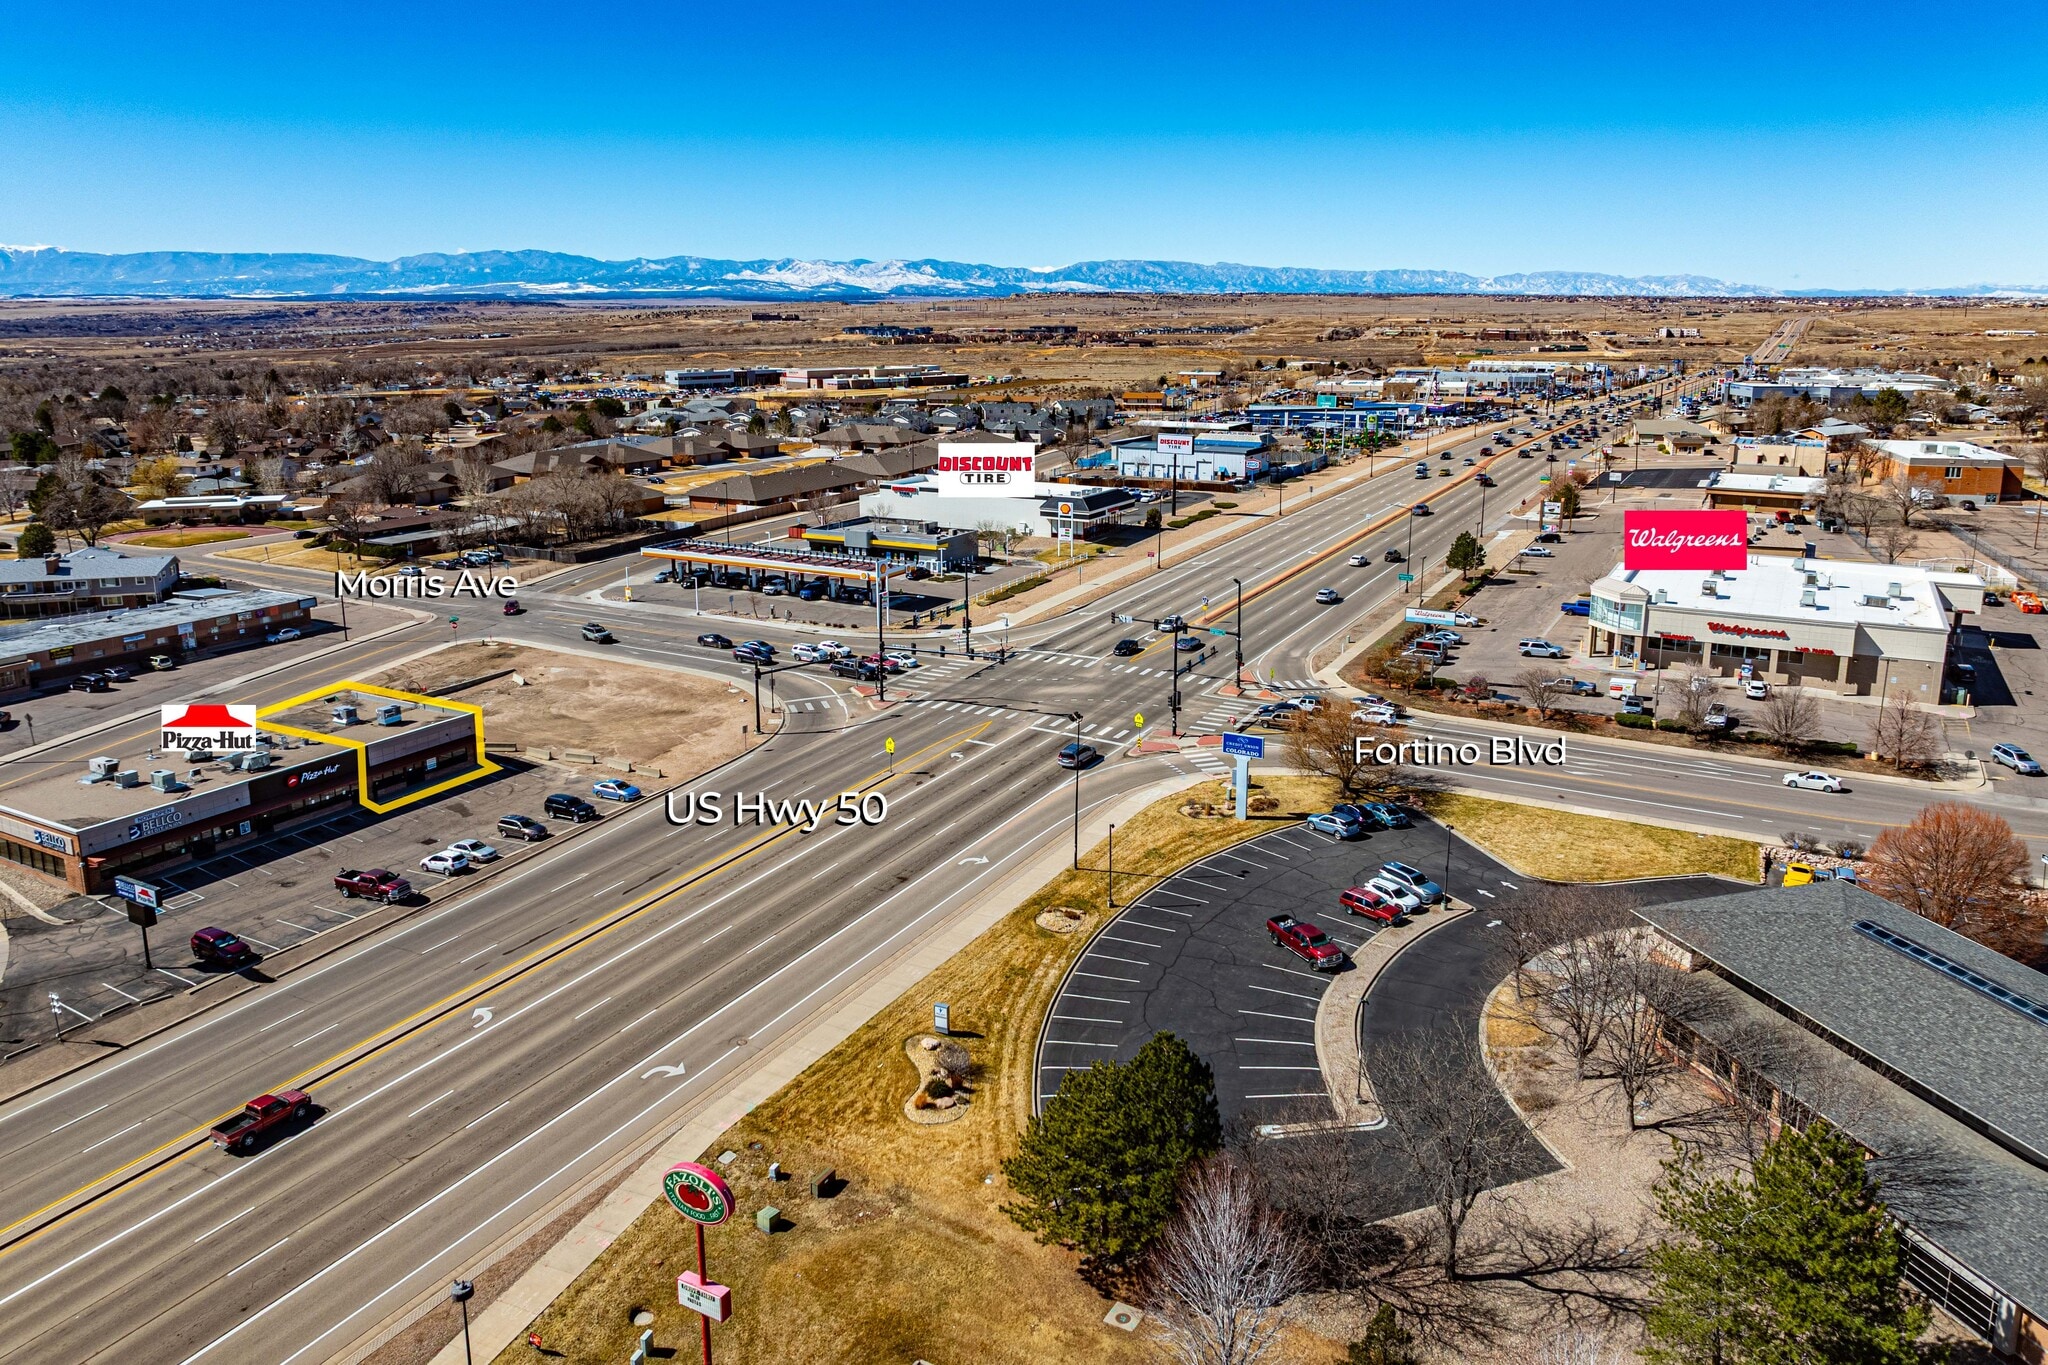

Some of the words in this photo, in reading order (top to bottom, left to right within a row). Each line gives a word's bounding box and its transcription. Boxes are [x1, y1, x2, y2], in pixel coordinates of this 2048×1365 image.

[1225, 747, 1260, 757] COLORADO
[301, 770, 322, 783] Pizza
[324, 764, 340, 775] Hut
[142, 812, 182, 831] BELLCO
[665, 1171, 722, 1206] FAZOLI'S
[668, 1190, 689, 1214] ITALIAN
